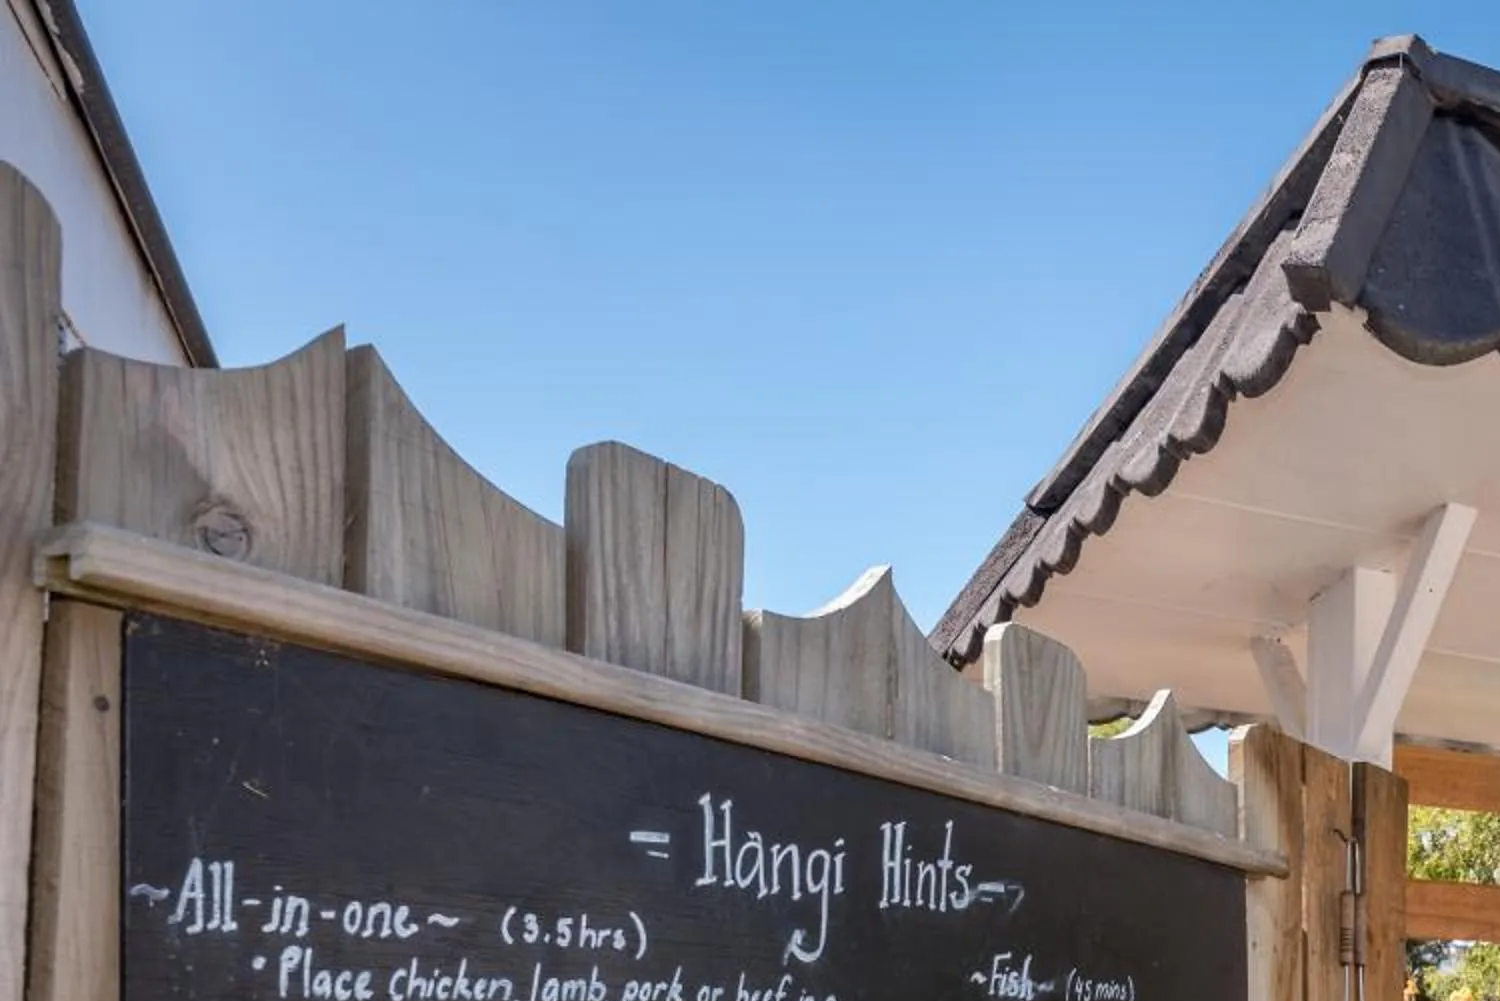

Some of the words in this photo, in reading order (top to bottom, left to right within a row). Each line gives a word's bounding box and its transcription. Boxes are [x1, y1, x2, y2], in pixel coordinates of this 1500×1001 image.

[694, 793, 846, 962] Hangi
[879, 820, 973, 912] Hints
[279, 946, 373, 999] Place
[988, 951, 1034, 1001] Fish
